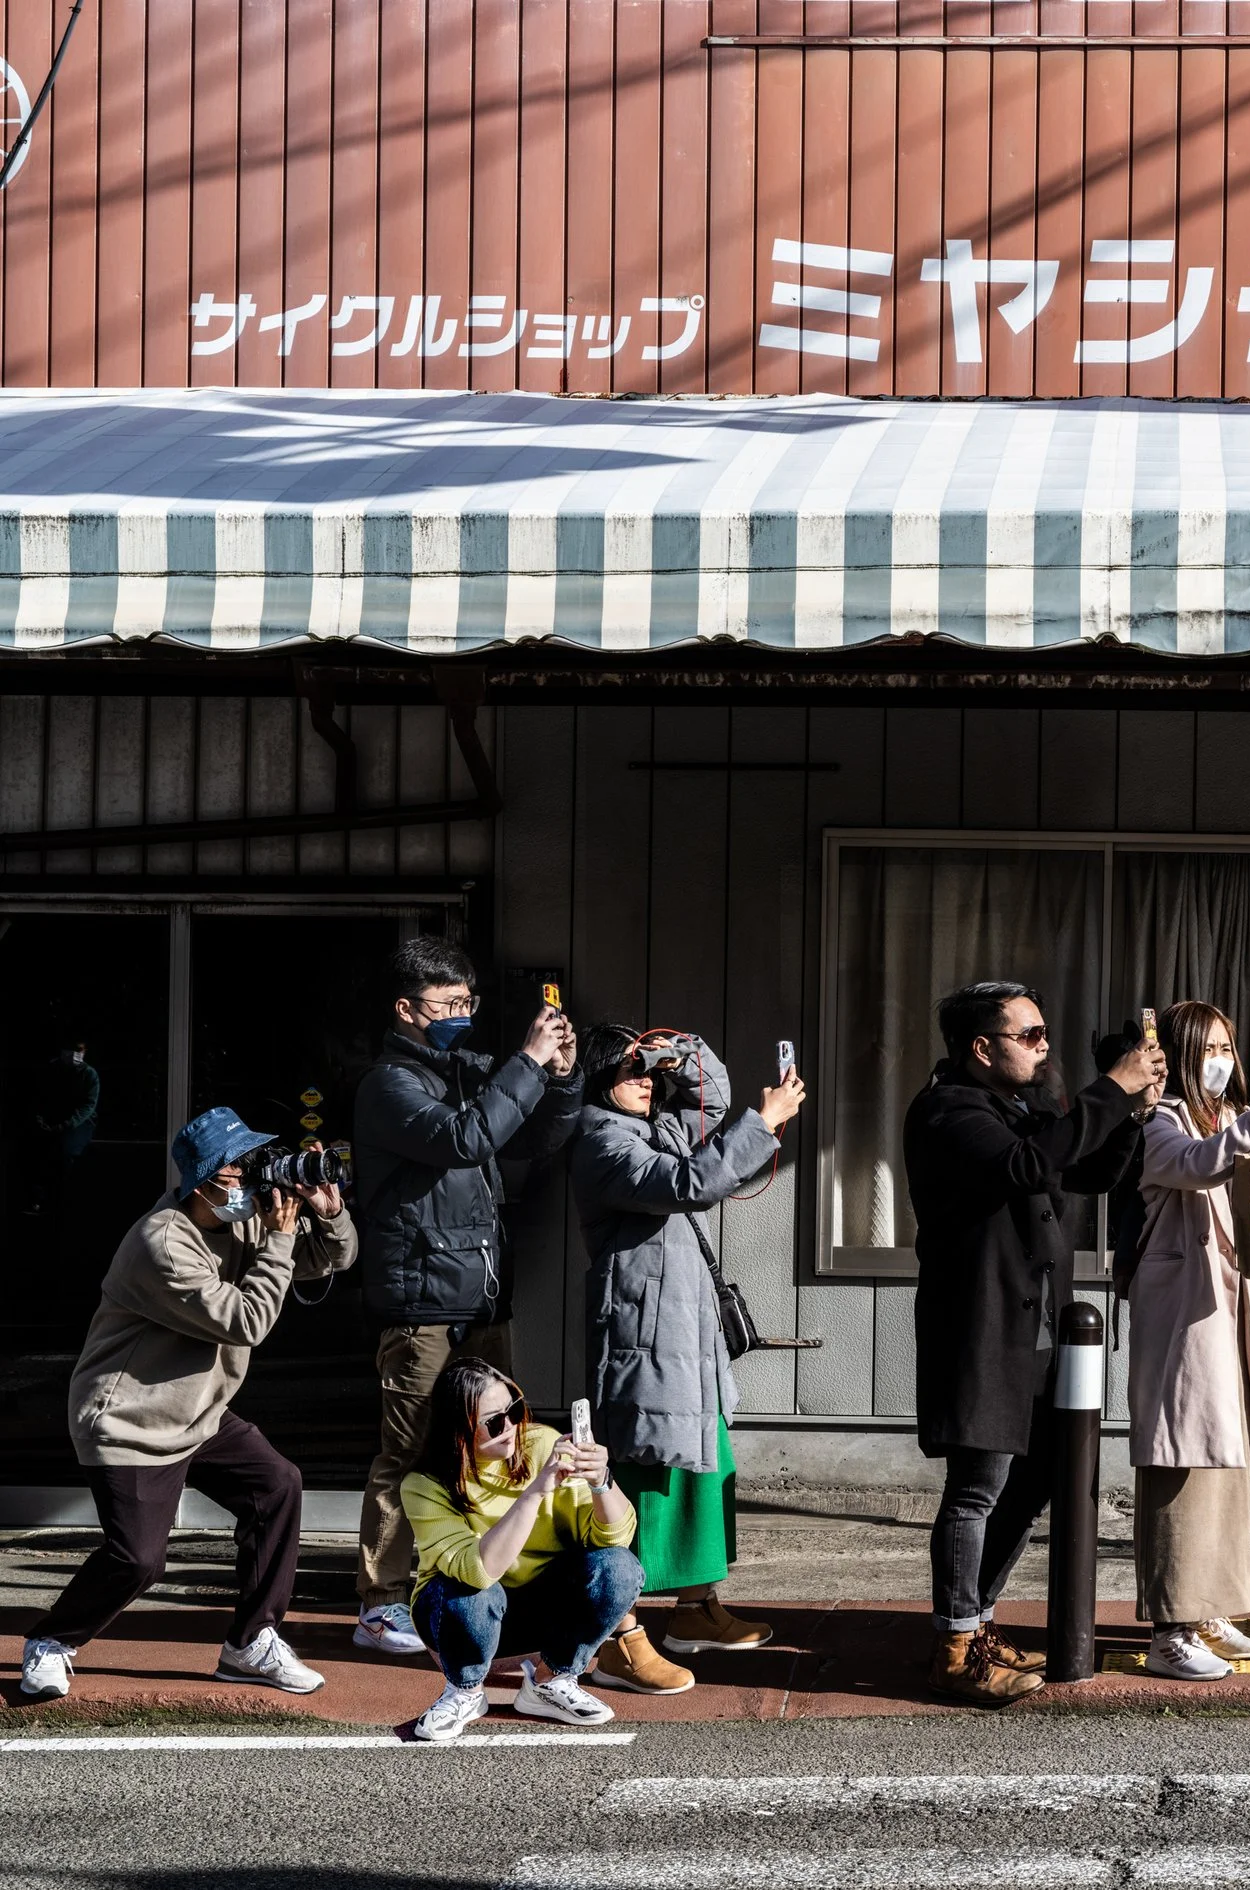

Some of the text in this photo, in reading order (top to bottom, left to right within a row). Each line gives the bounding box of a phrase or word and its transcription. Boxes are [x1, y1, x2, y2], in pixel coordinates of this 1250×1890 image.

[190, 293, 705, 360] サイクルショップ
